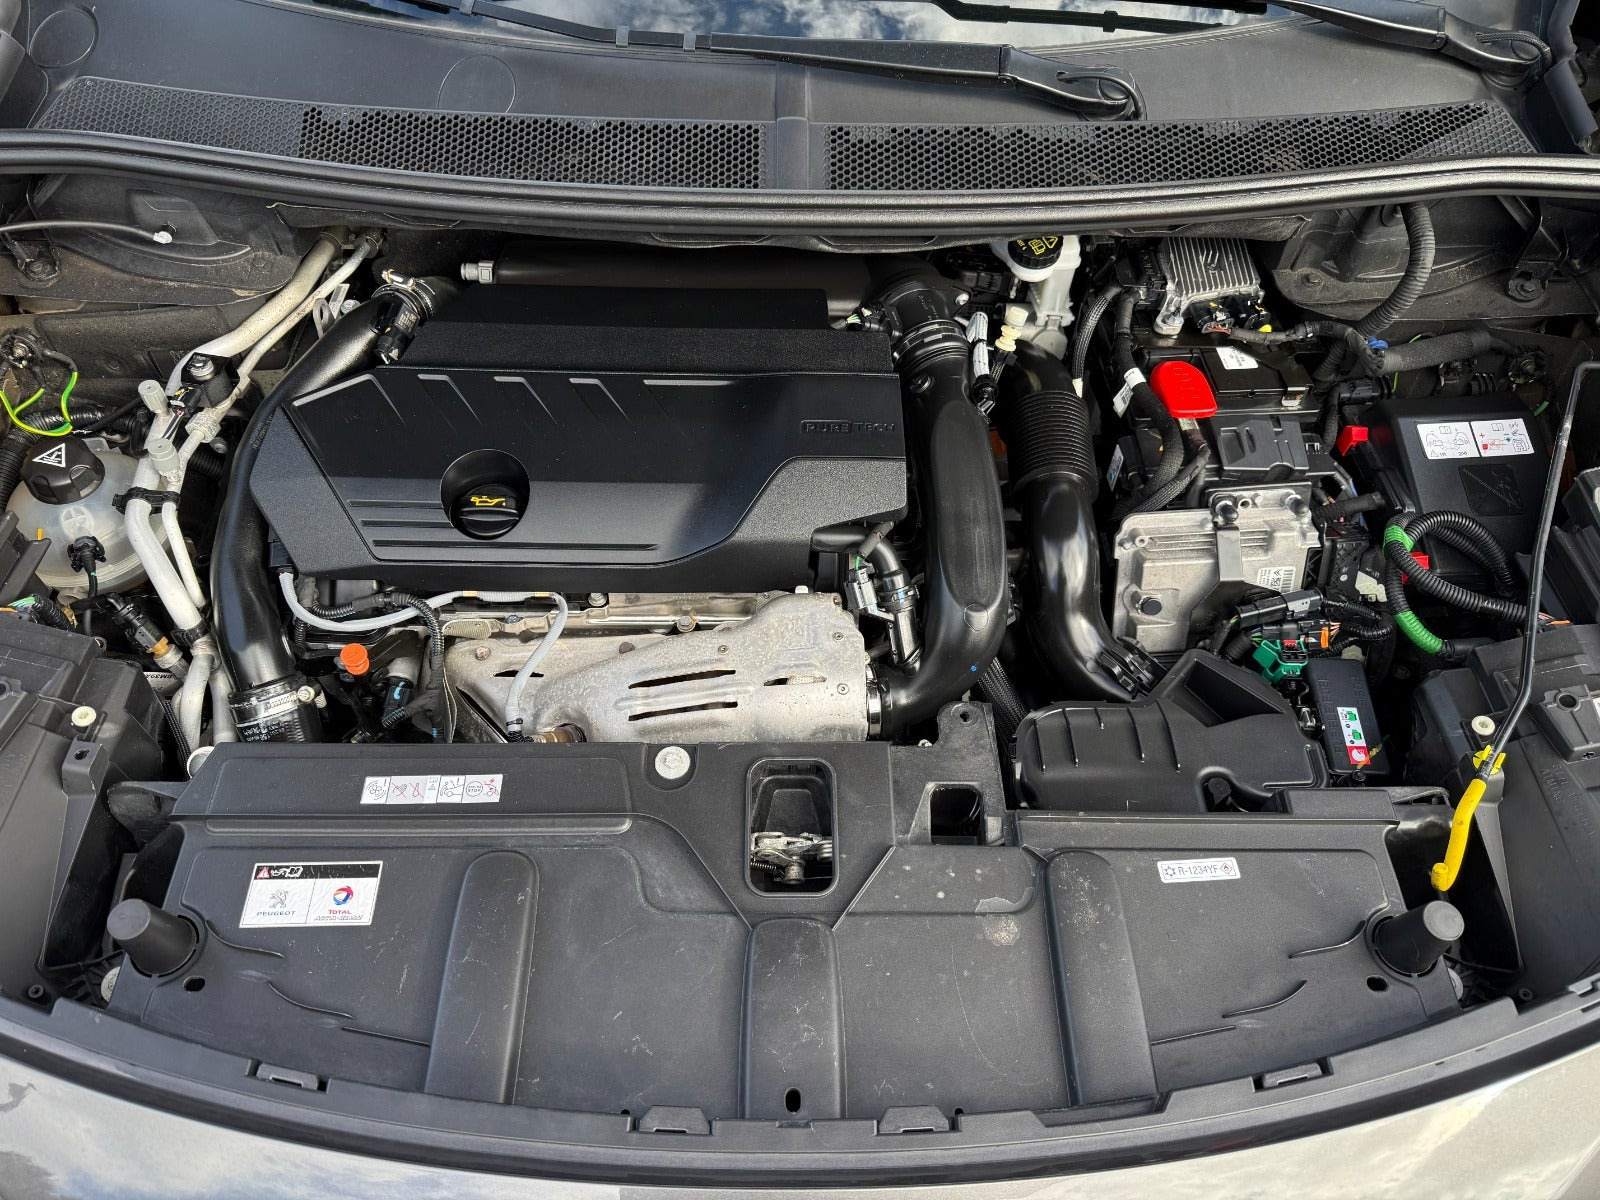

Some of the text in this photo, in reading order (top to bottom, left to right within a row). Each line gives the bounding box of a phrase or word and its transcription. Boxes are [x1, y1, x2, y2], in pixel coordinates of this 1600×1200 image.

[806, 422, 895, 432] PURE TECH
[1178, 864, 1219, 875] R-1234YF
